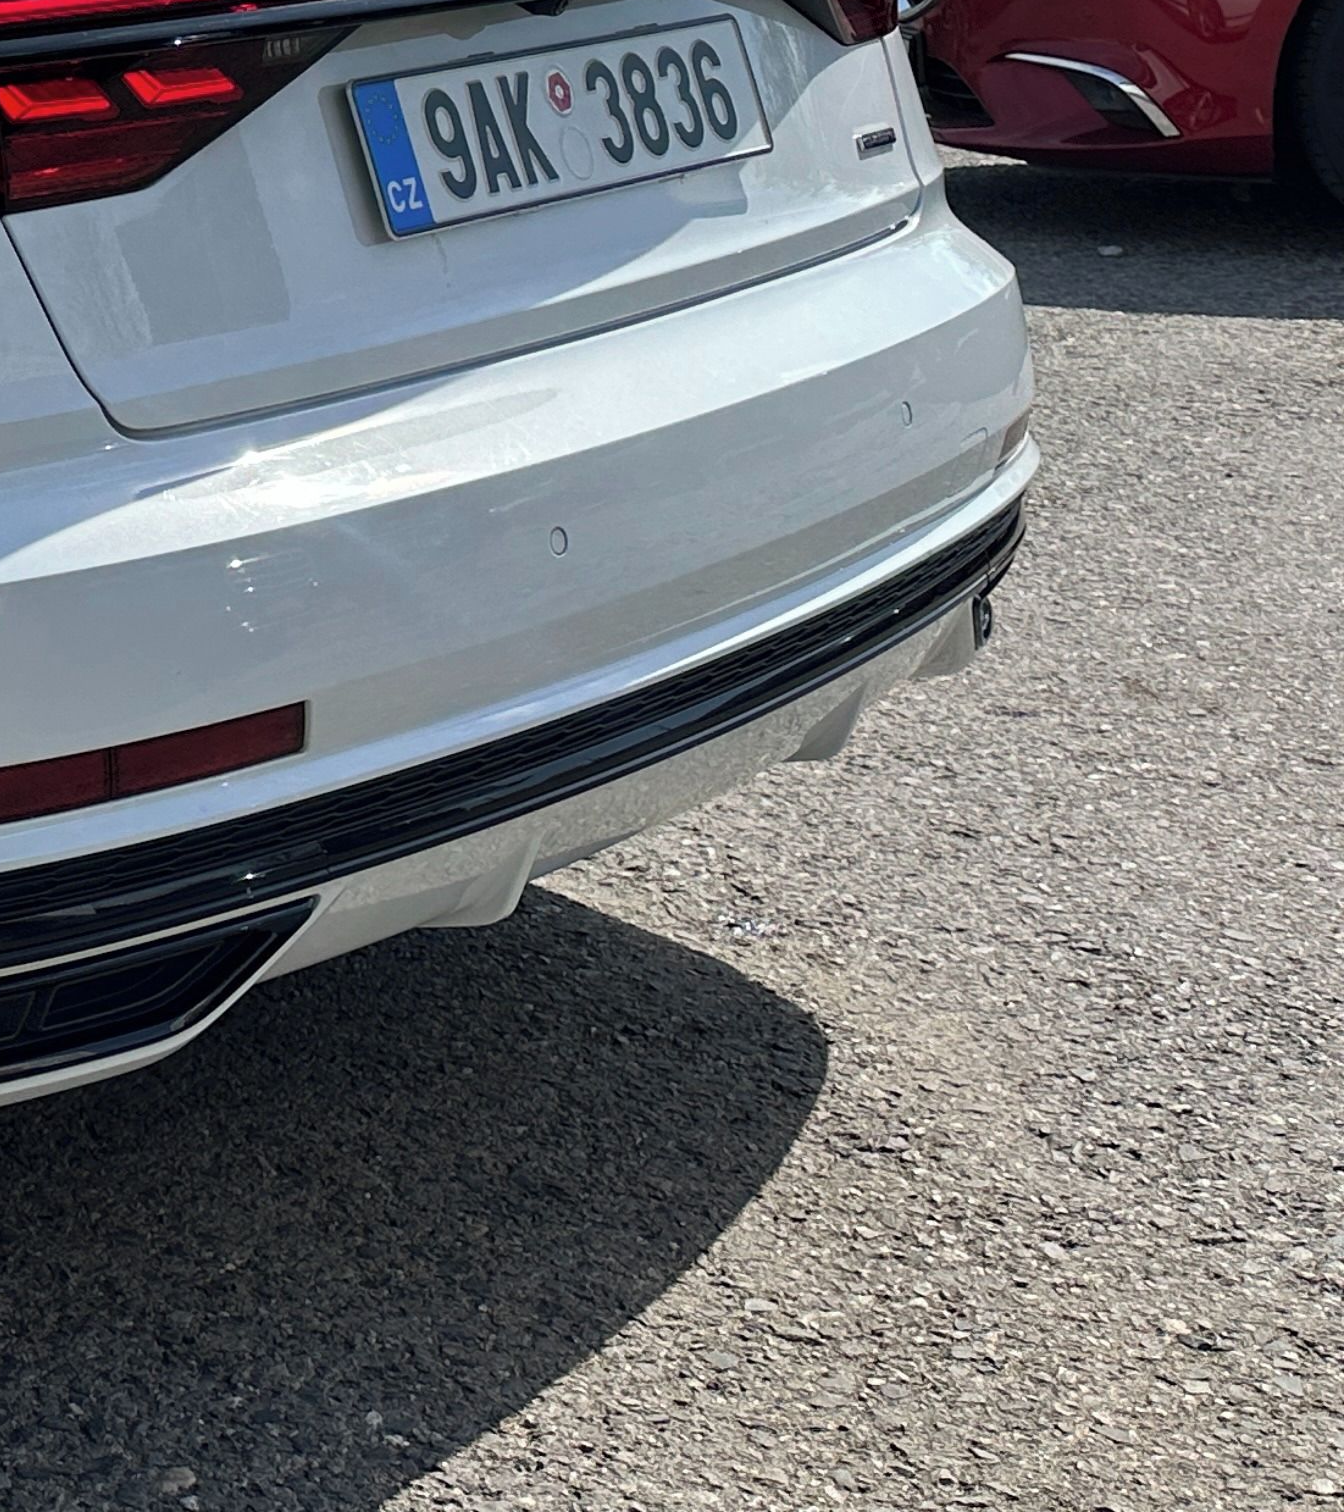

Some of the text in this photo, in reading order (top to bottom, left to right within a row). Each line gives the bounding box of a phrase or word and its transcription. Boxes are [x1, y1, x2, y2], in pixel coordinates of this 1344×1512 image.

[424, 39, 738, 200] 9AK 3836
[387, 177, 423, 213] CZ
